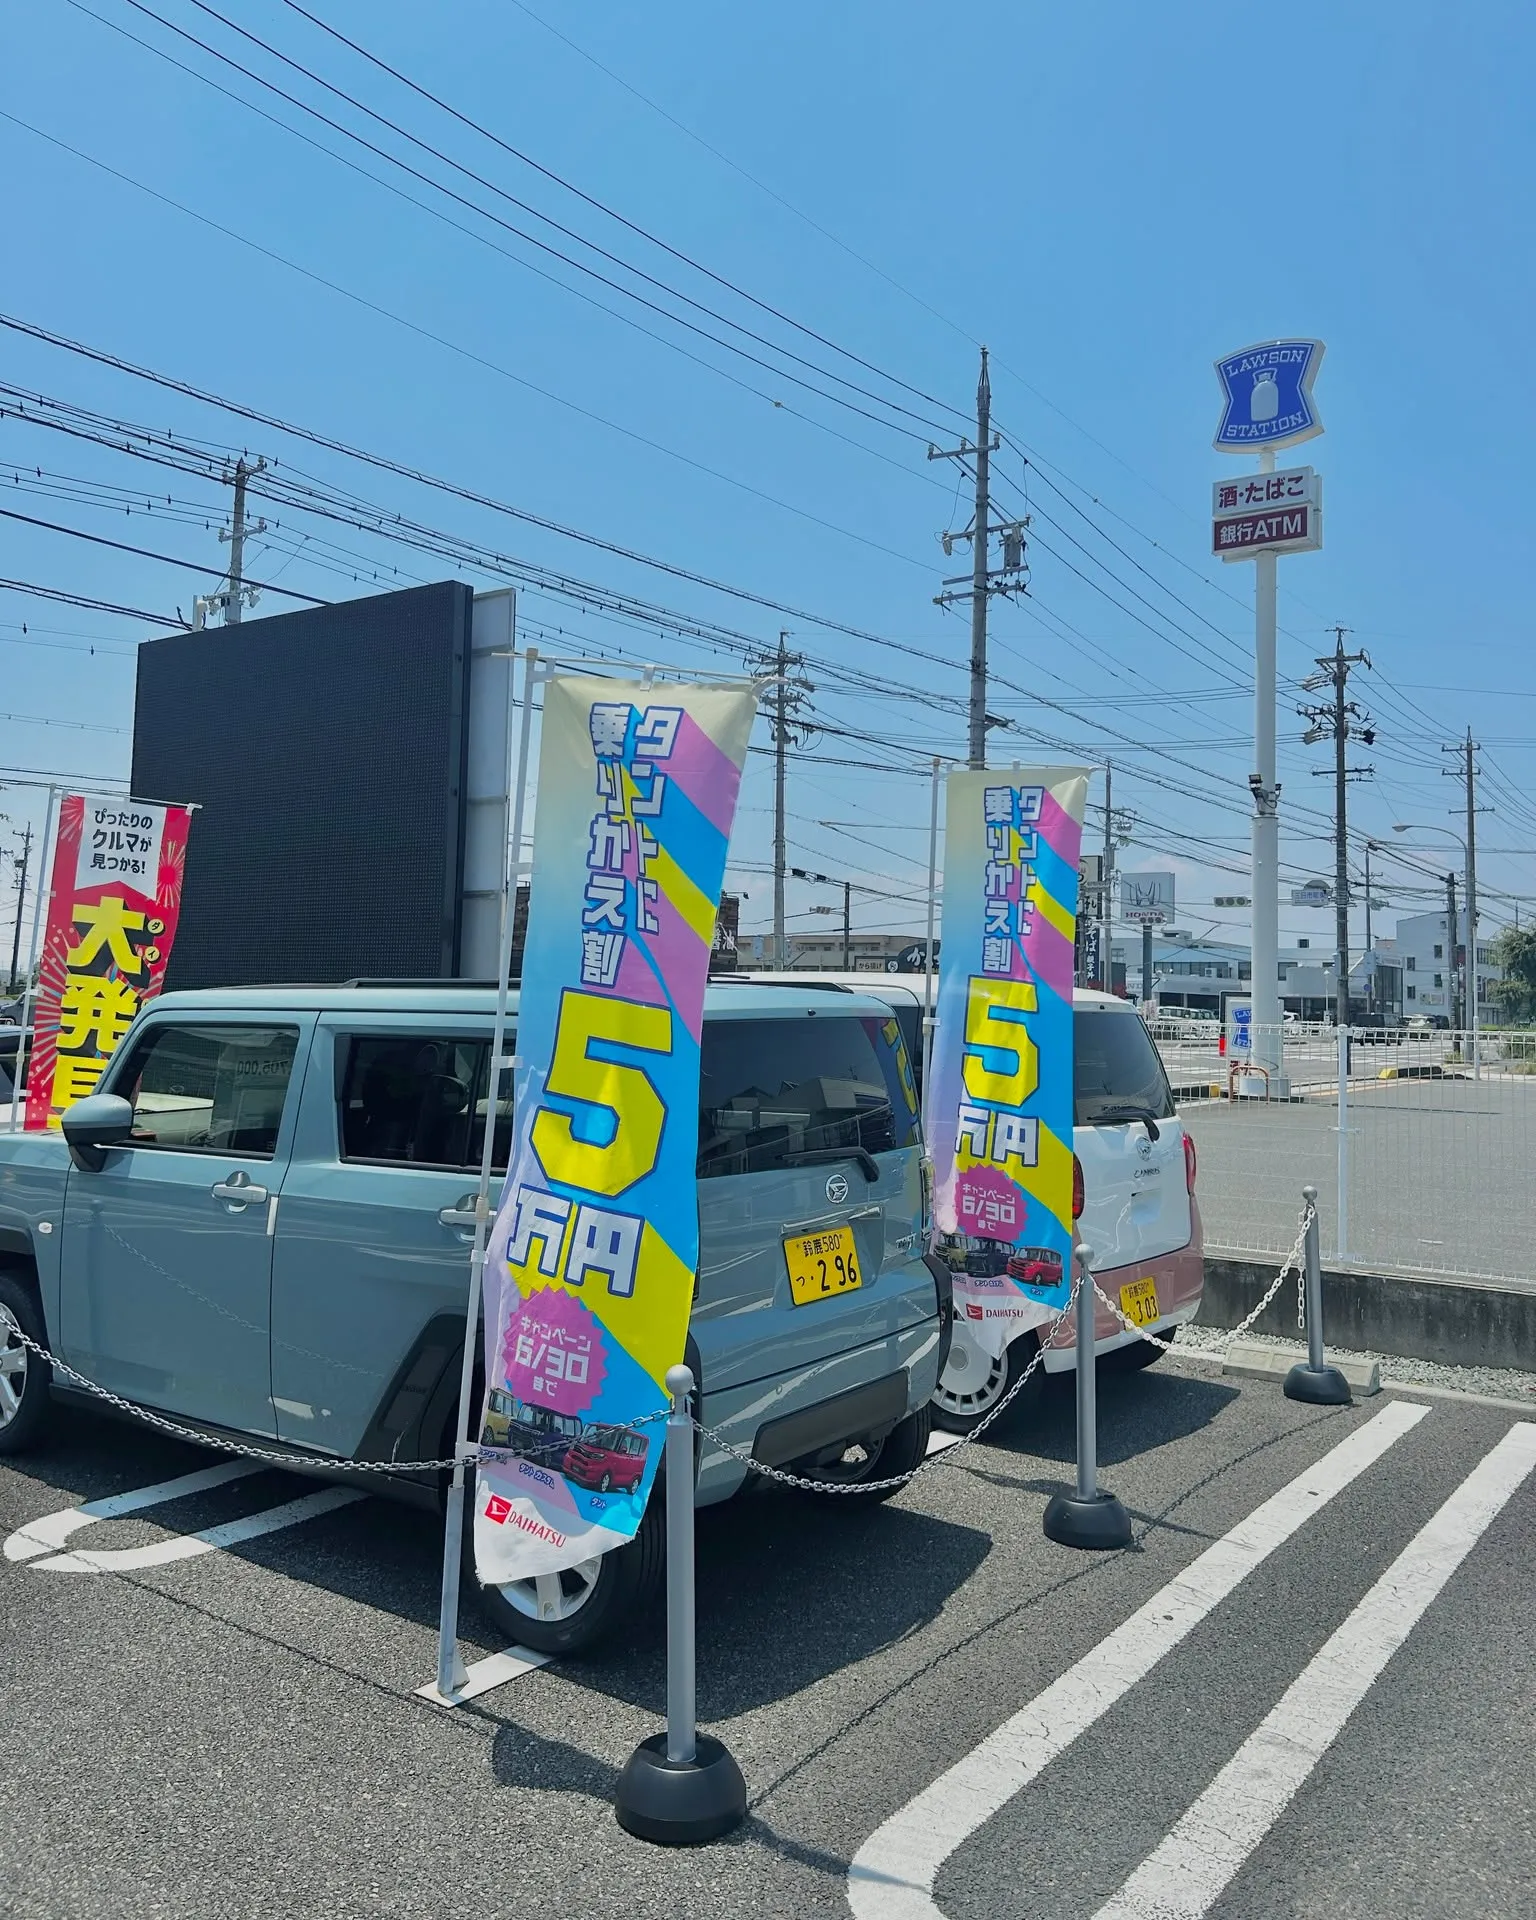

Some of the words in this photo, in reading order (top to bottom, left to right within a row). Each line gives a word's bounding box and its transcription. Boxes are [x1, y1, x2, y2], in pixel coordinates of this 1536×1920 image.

[1227, 350, 1304, 377] LAWSON
[1226, 411, 1304, 437] STATION
[1218, 475, 1304, 508] 酒・たばこ
[1219, 513, 1302, 545] 銀行ATM
[94, 808, 153, 830] ぴったりの
[634, 704, 685, 936] タントに
[92, 829, 152, 853] クルマが
[1017, 786, 1045, 937] タントに
[961, 974, 1040, 1107] 5
[529, 986, 674, 1200] 5
[955, 1102, 1040, 1168] 万円
[962, 1183, 1016, 1204] キャンペーン
[962, 1195, 1016, 1224] 6/30
[506, 1183, 646, 1298] 万円
[977, 1219, 997, 1232] まで
[802, 1234, 841, 1258] 鈴鹿580
[985, 1309, 1024, 1318] DAIHATSU
[520, 1315, 592, 1352] キャンペーン
[514, 1333, 590, 1384] 6/30
[532, 1375, 558, 1397] まで
[590, 1496, 607, 1509] タント
[508, 1511, 567, 1548] DAIHATSU
